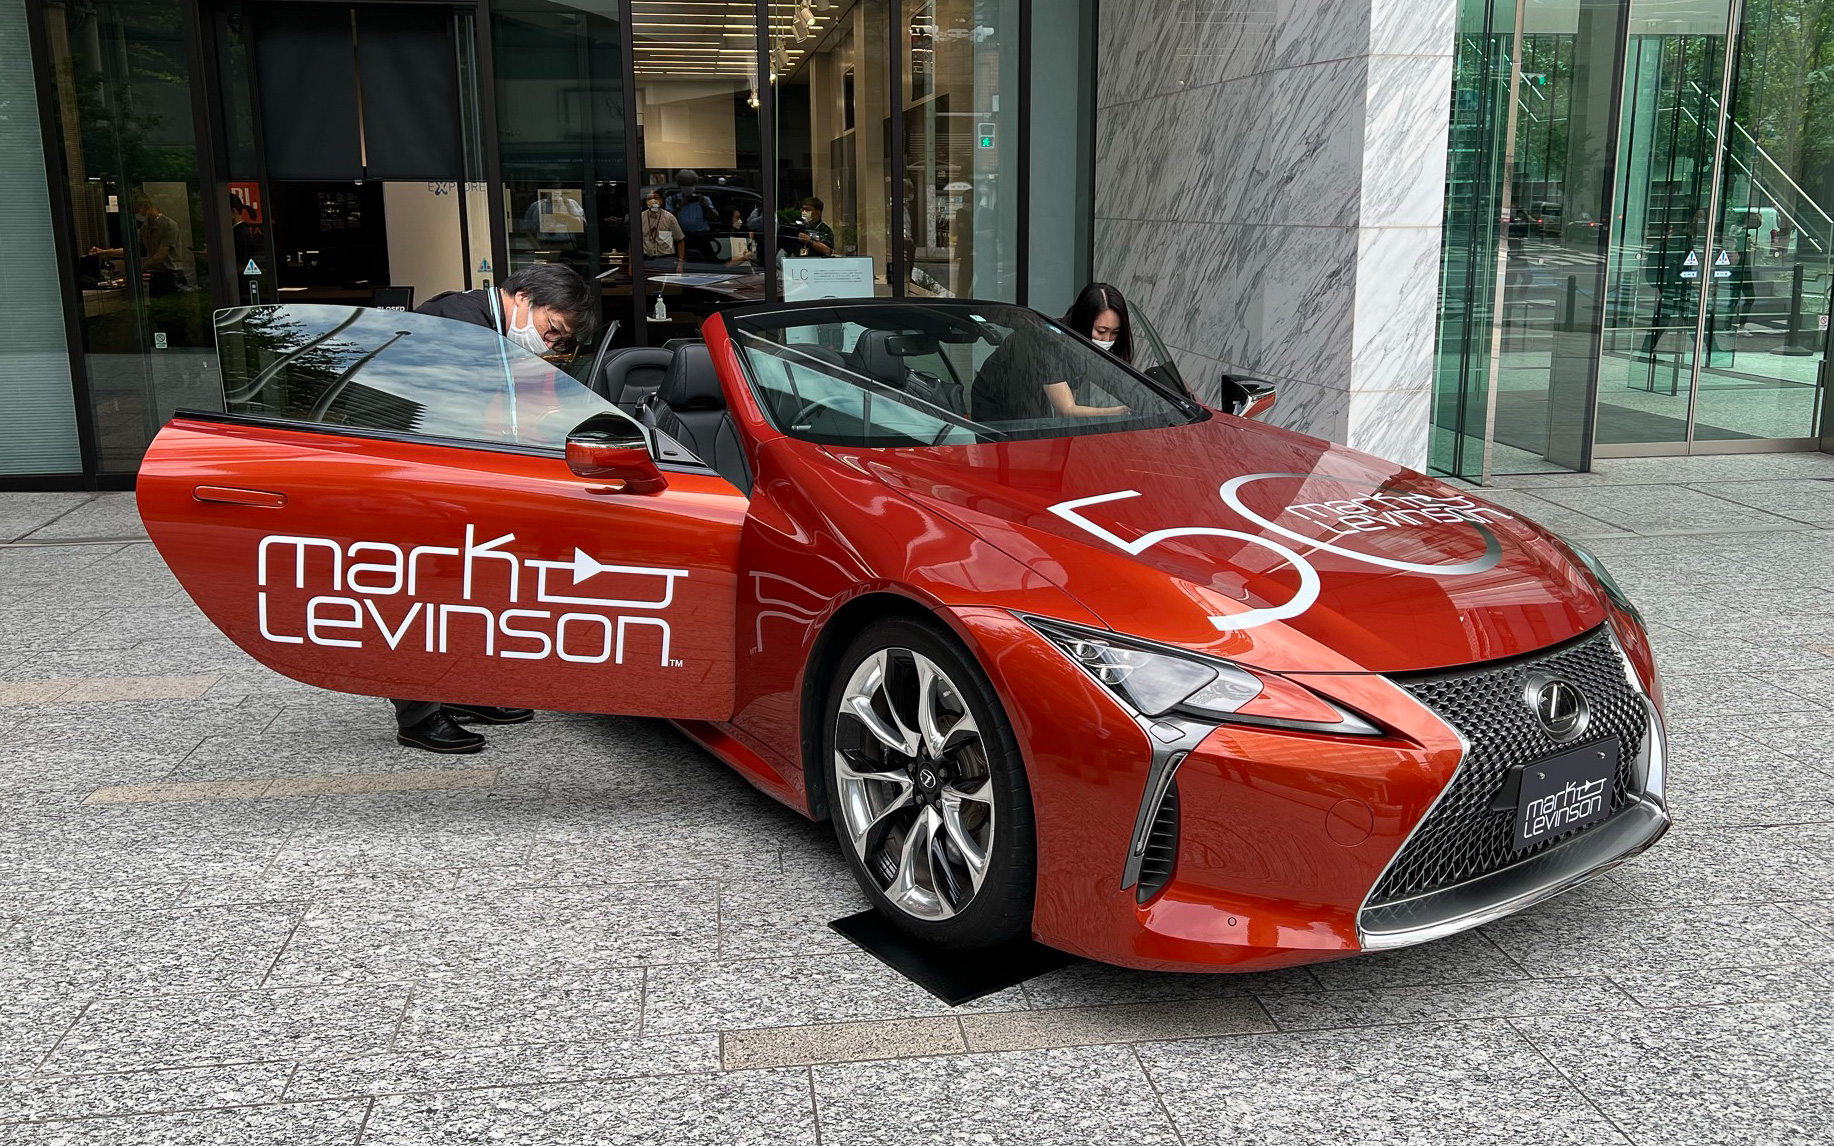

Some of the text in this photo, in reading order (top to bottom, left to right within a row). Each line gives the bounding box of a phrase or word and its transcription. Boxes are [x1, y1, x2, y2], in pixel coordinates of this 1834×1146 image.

[428, 181, 486, 195] EXPORE
[791, 268, 809, 281] LC
[258, 524, 518, 602] mark
[1526, 781, 1577, 820] mark
